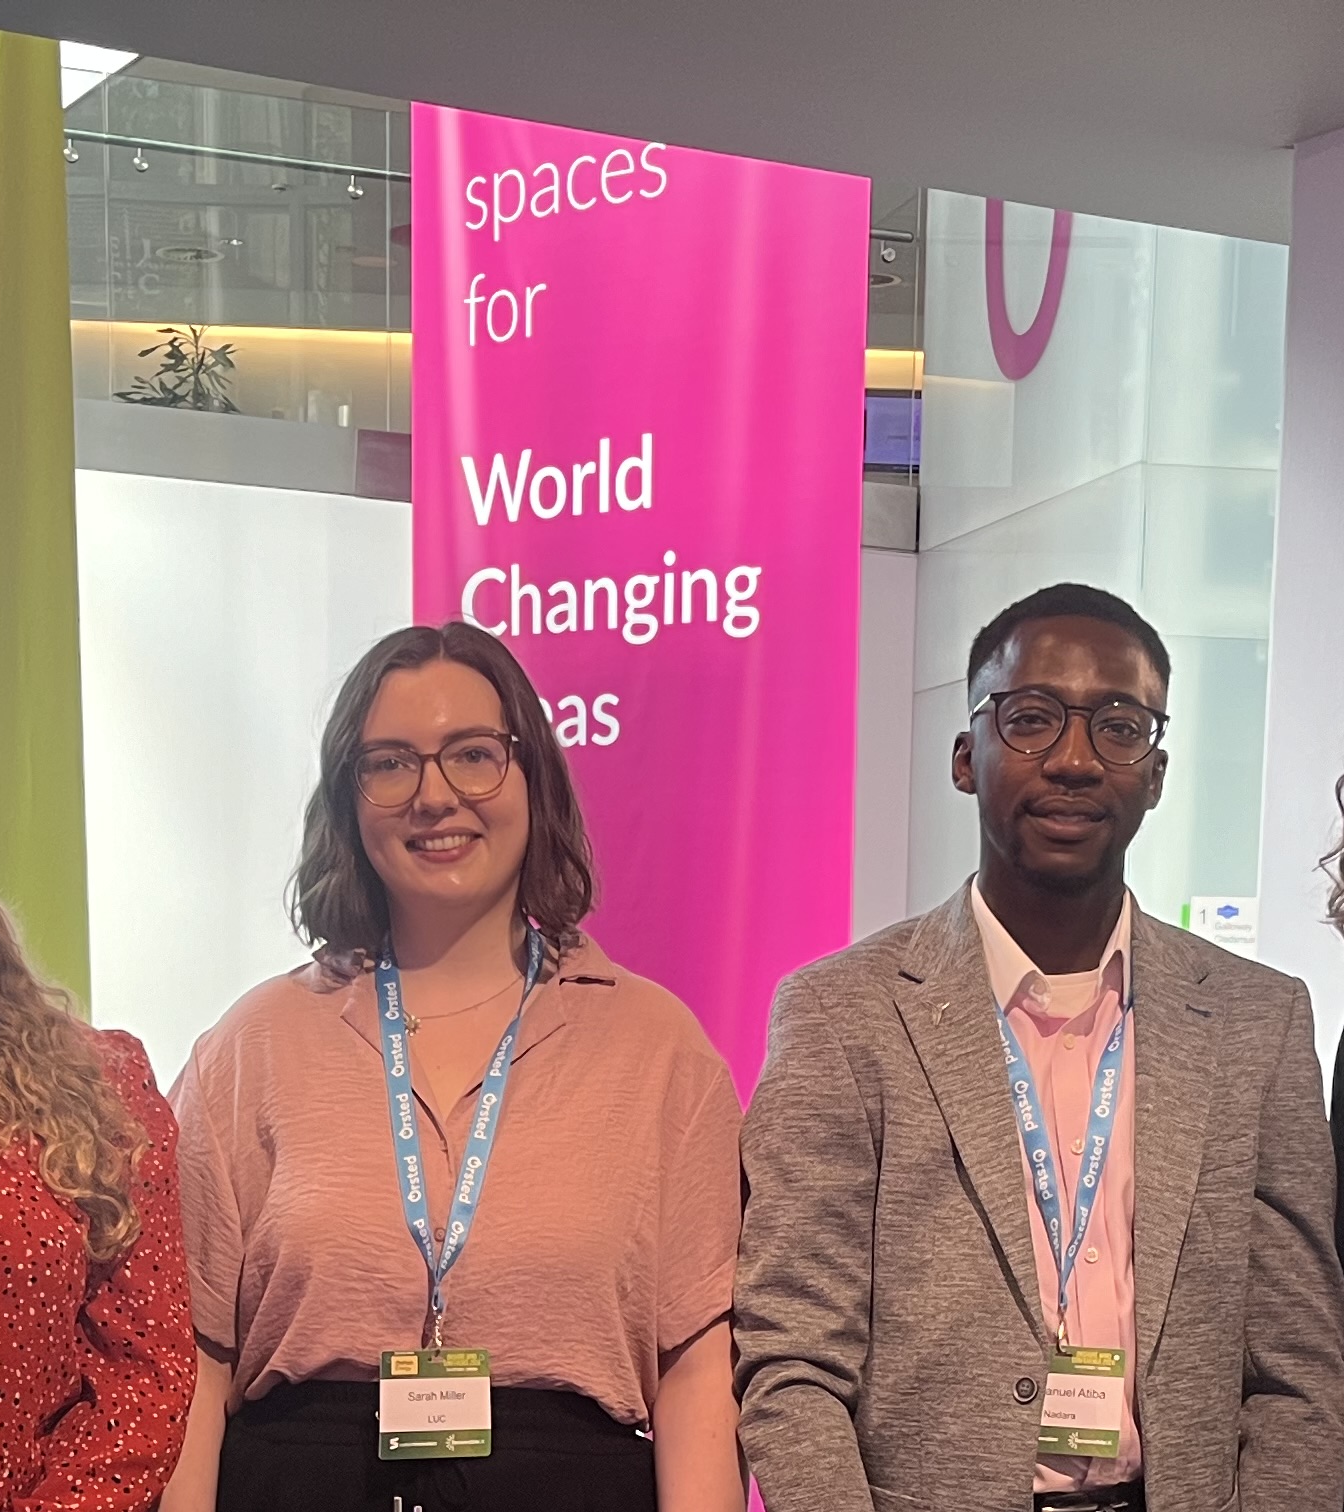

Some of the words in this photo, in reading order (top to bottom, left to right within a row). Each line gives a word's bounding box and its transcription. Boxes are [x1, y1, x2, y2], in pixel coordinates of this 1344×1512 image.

[464, 141, 668, 242] spaces
[462, 273, 547, 347] for
[460, 432, 653, 527] World
[460, 550, 763, 646] Changing
[407, 1390, 437, 1402] Sarah
[439, 1390, 466, 1401] Miller
